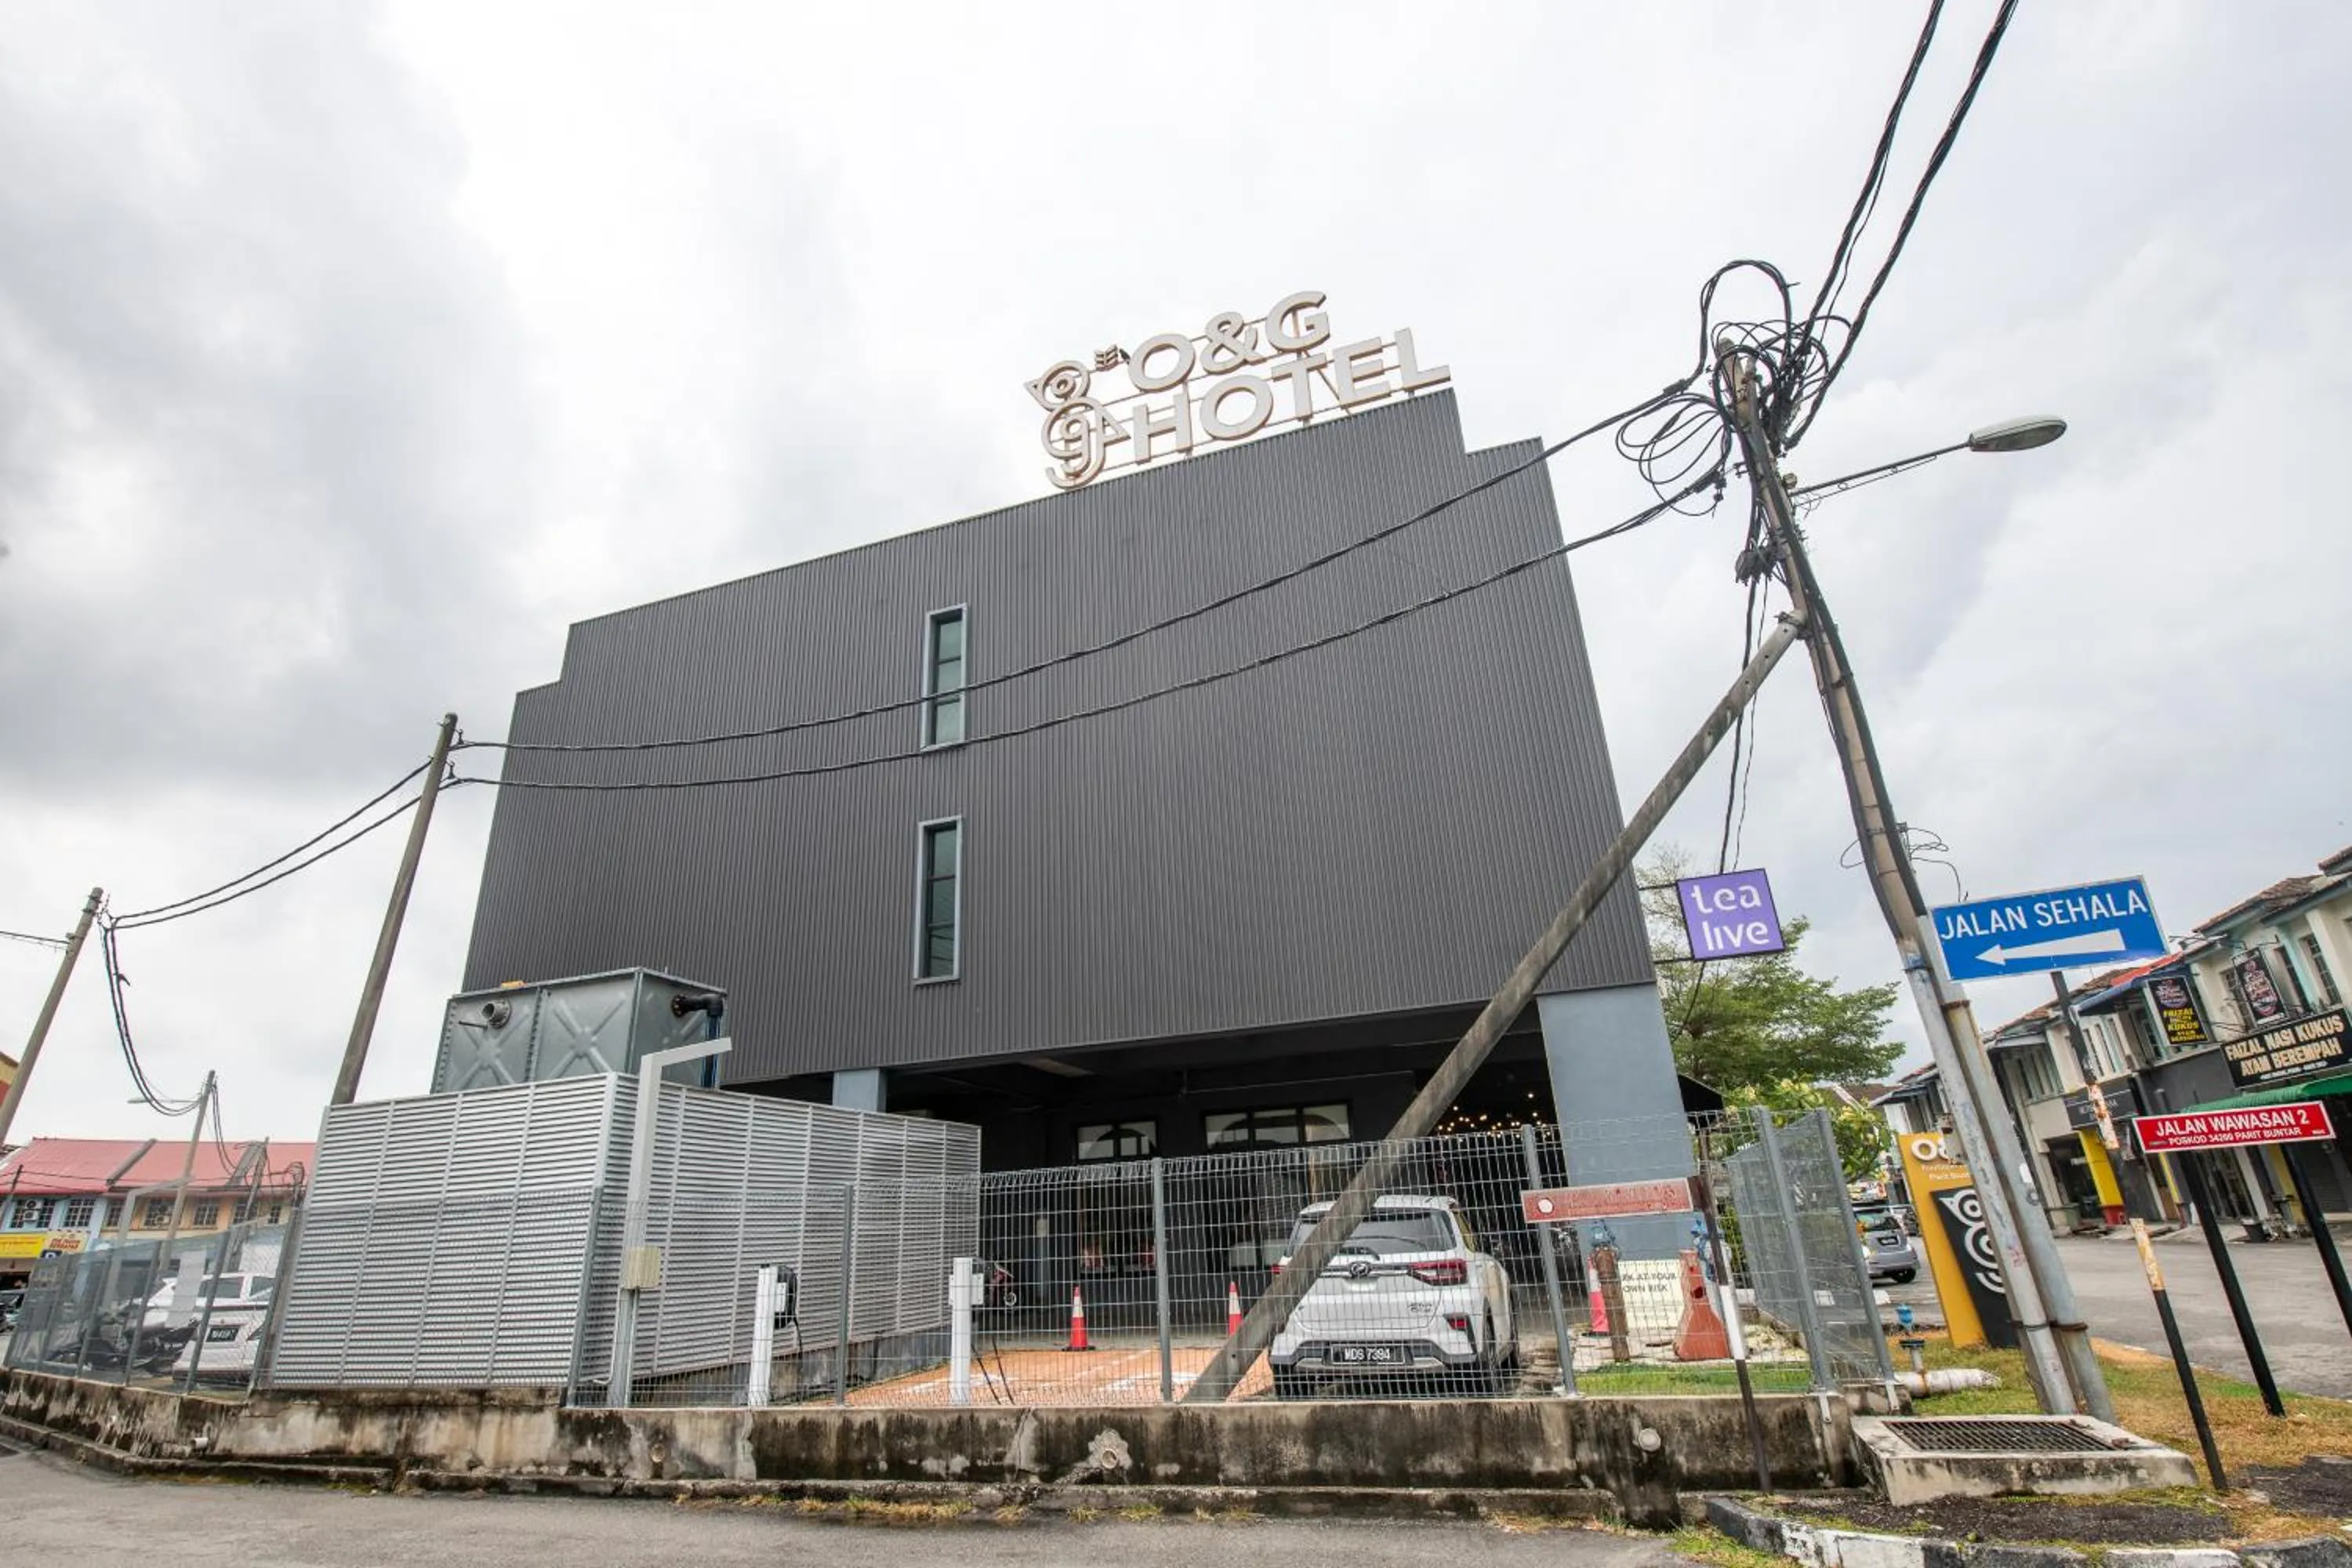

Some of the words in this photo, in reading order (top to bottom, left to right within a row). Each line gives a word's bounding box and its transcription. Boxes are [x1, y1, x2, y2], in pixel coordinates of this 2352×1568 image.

[1127, 290, 1330, 392] O&G
[1132, 326, 1451, 466] HOTEL
[1690, 884, 1762, 914] tea
[1940, 906, 2028, 941] JALAN
[2033, 888, 2148, 927] SEHALA
[1701, 920, 1769, 952] live
[2224, 1037, 2266, 1061] FAIZAL
[2263, 1028, 2296, 1051] NASI
[2294, 1014, 2345, 1042] KUKUS
[2240, 1054, 2272, 1076] AYAM
[2270, 1036, 2343, 1069] BEREMPAH
[2156, 1117, 2207, 1138] JALAN
[2208, 1110, 2296, 1132] WAWASAN
[2297, 1109, 2310, 1124] 2
[2169, 1136, 2207, 1146] POSKOD
[2234, 1131, 2262, 1141] PARIT
[2262, 1127, 2303, 1138] BUNTAR
